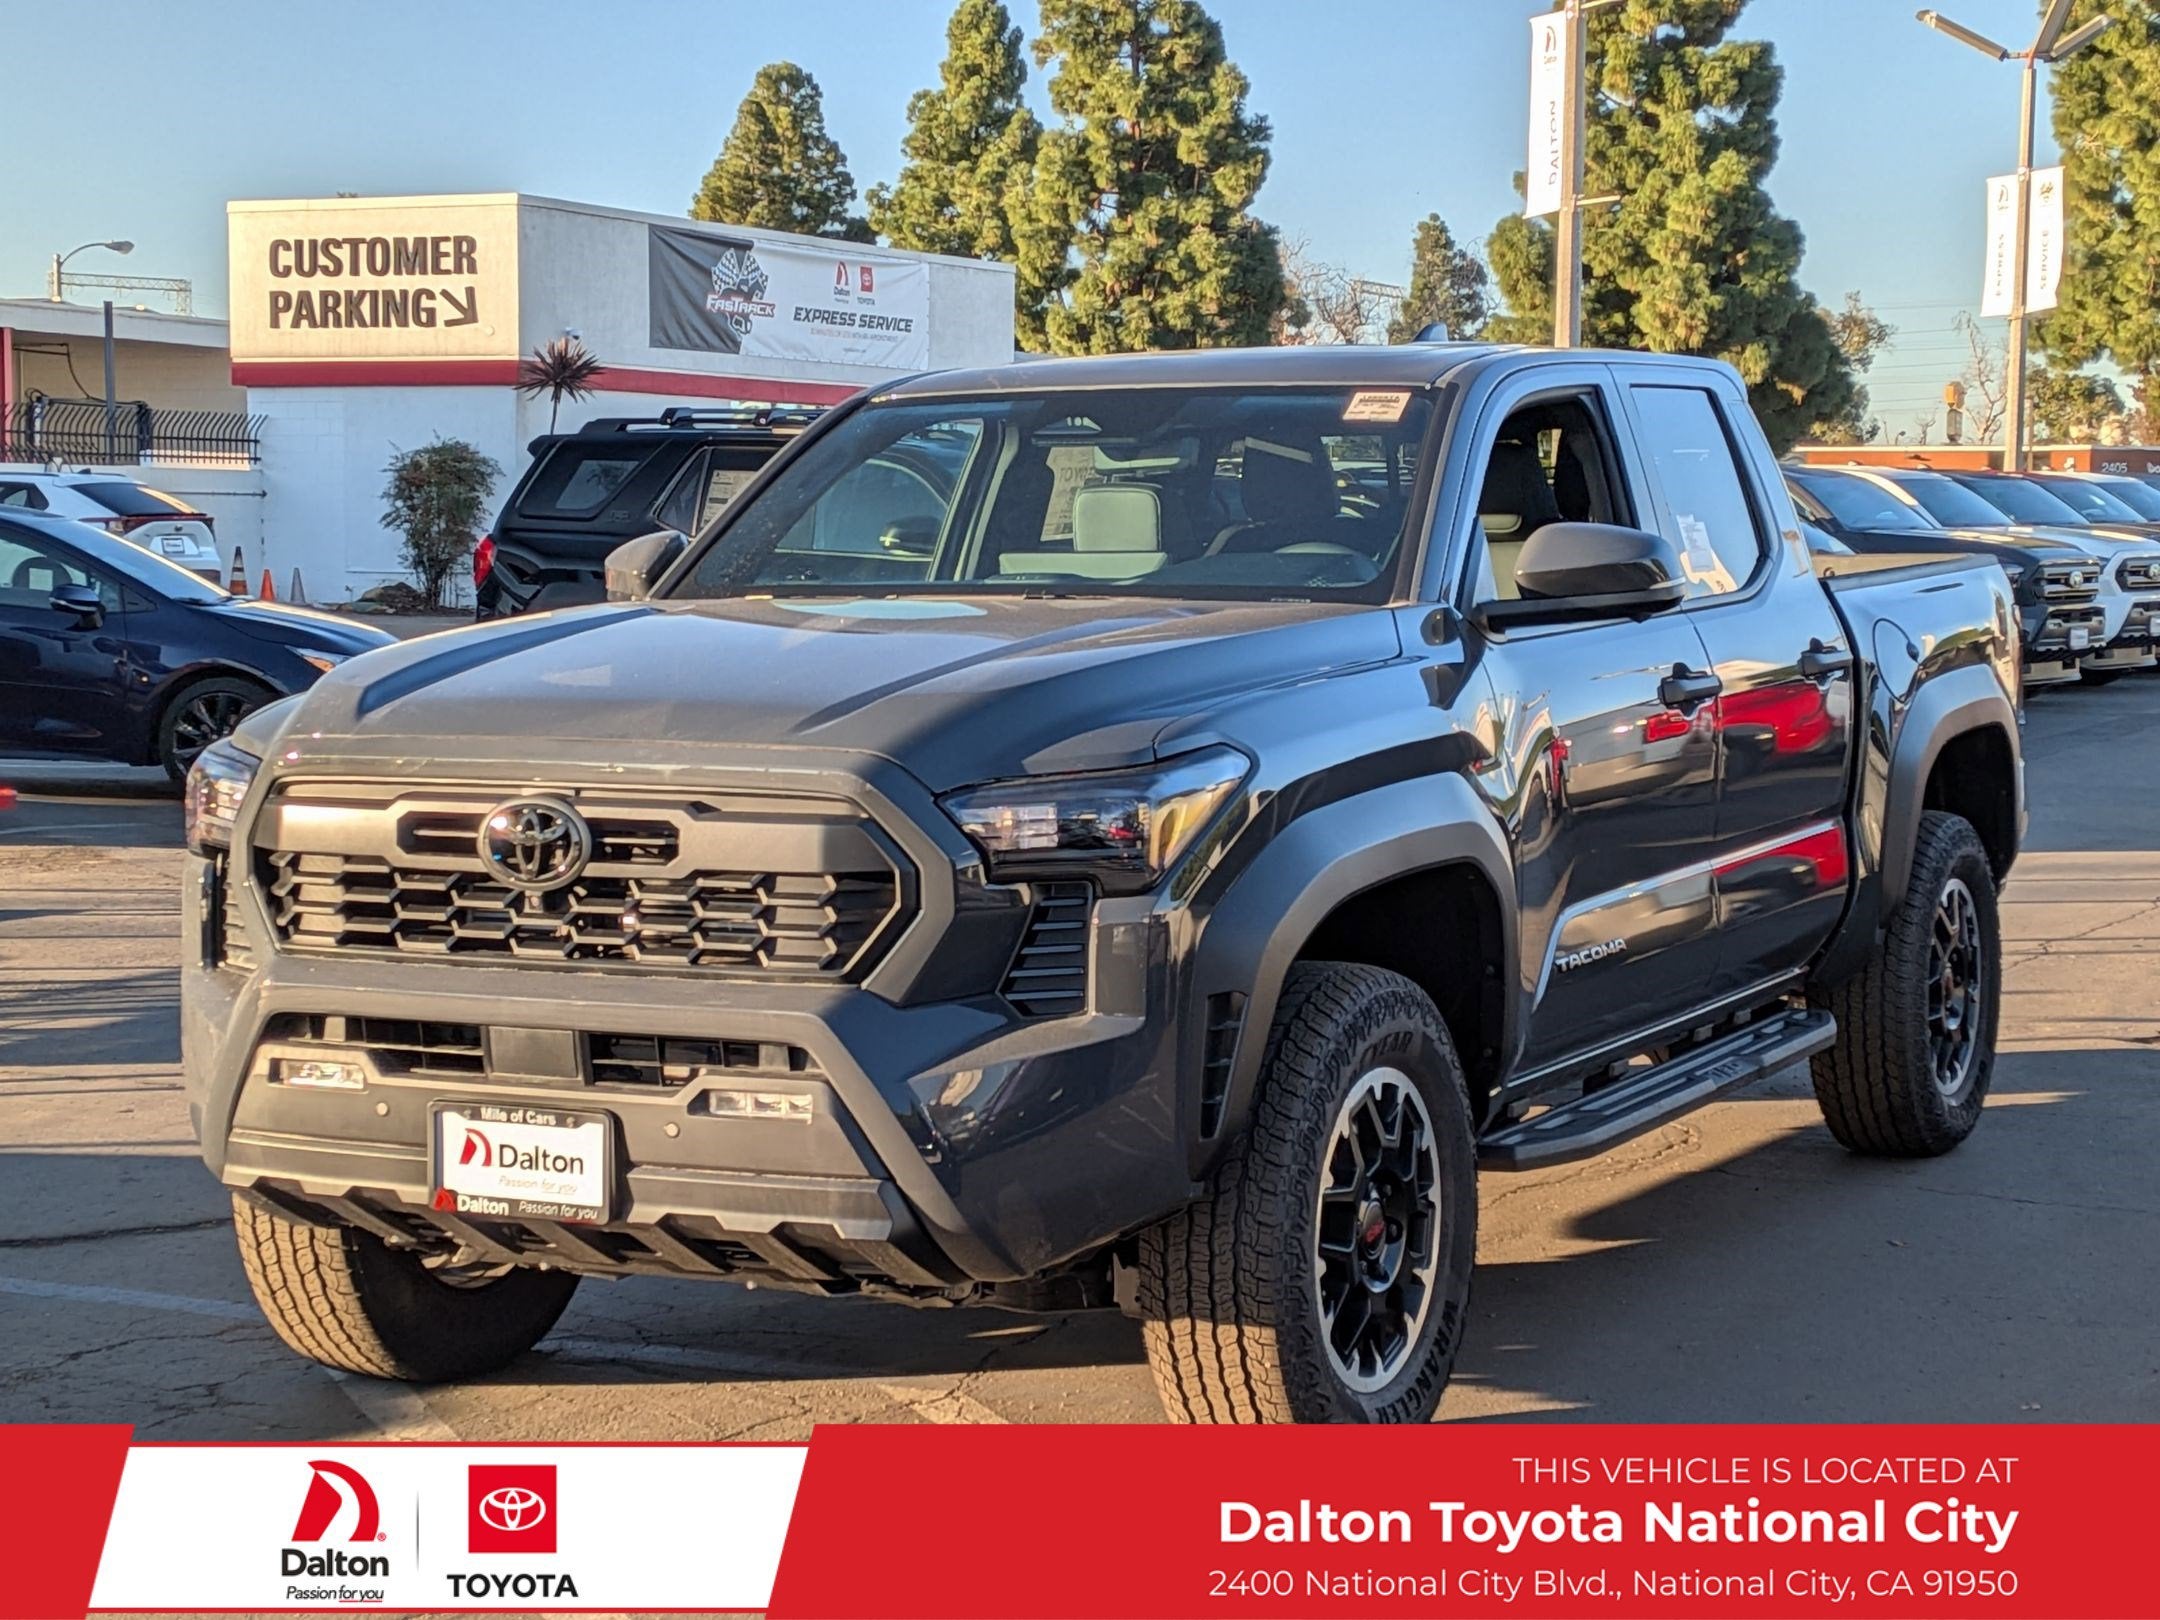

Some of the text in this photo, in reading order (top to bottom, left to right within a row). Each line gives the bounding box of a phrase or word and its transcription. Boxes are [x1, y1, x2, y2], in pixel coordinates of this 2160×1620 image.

[269, 235, 478, 278] CUSTOMER
[269, 288, 437, 329] PARKING
[793, 306, 913, 332] EXPRESS SERVICE
[2101, 462, 2128, 473] 2405
[1555, 939, 1626, 972] TACOMA
[481, 1107, 556, 1126] Mile of Cars
[499, 1144, 583, 1175] Dalton
[499, 1176, 578, 1195] Passion for you
[457, 1195, 509, 1216] Dalton
[519, 1201, 599, 1221] Passion for you
